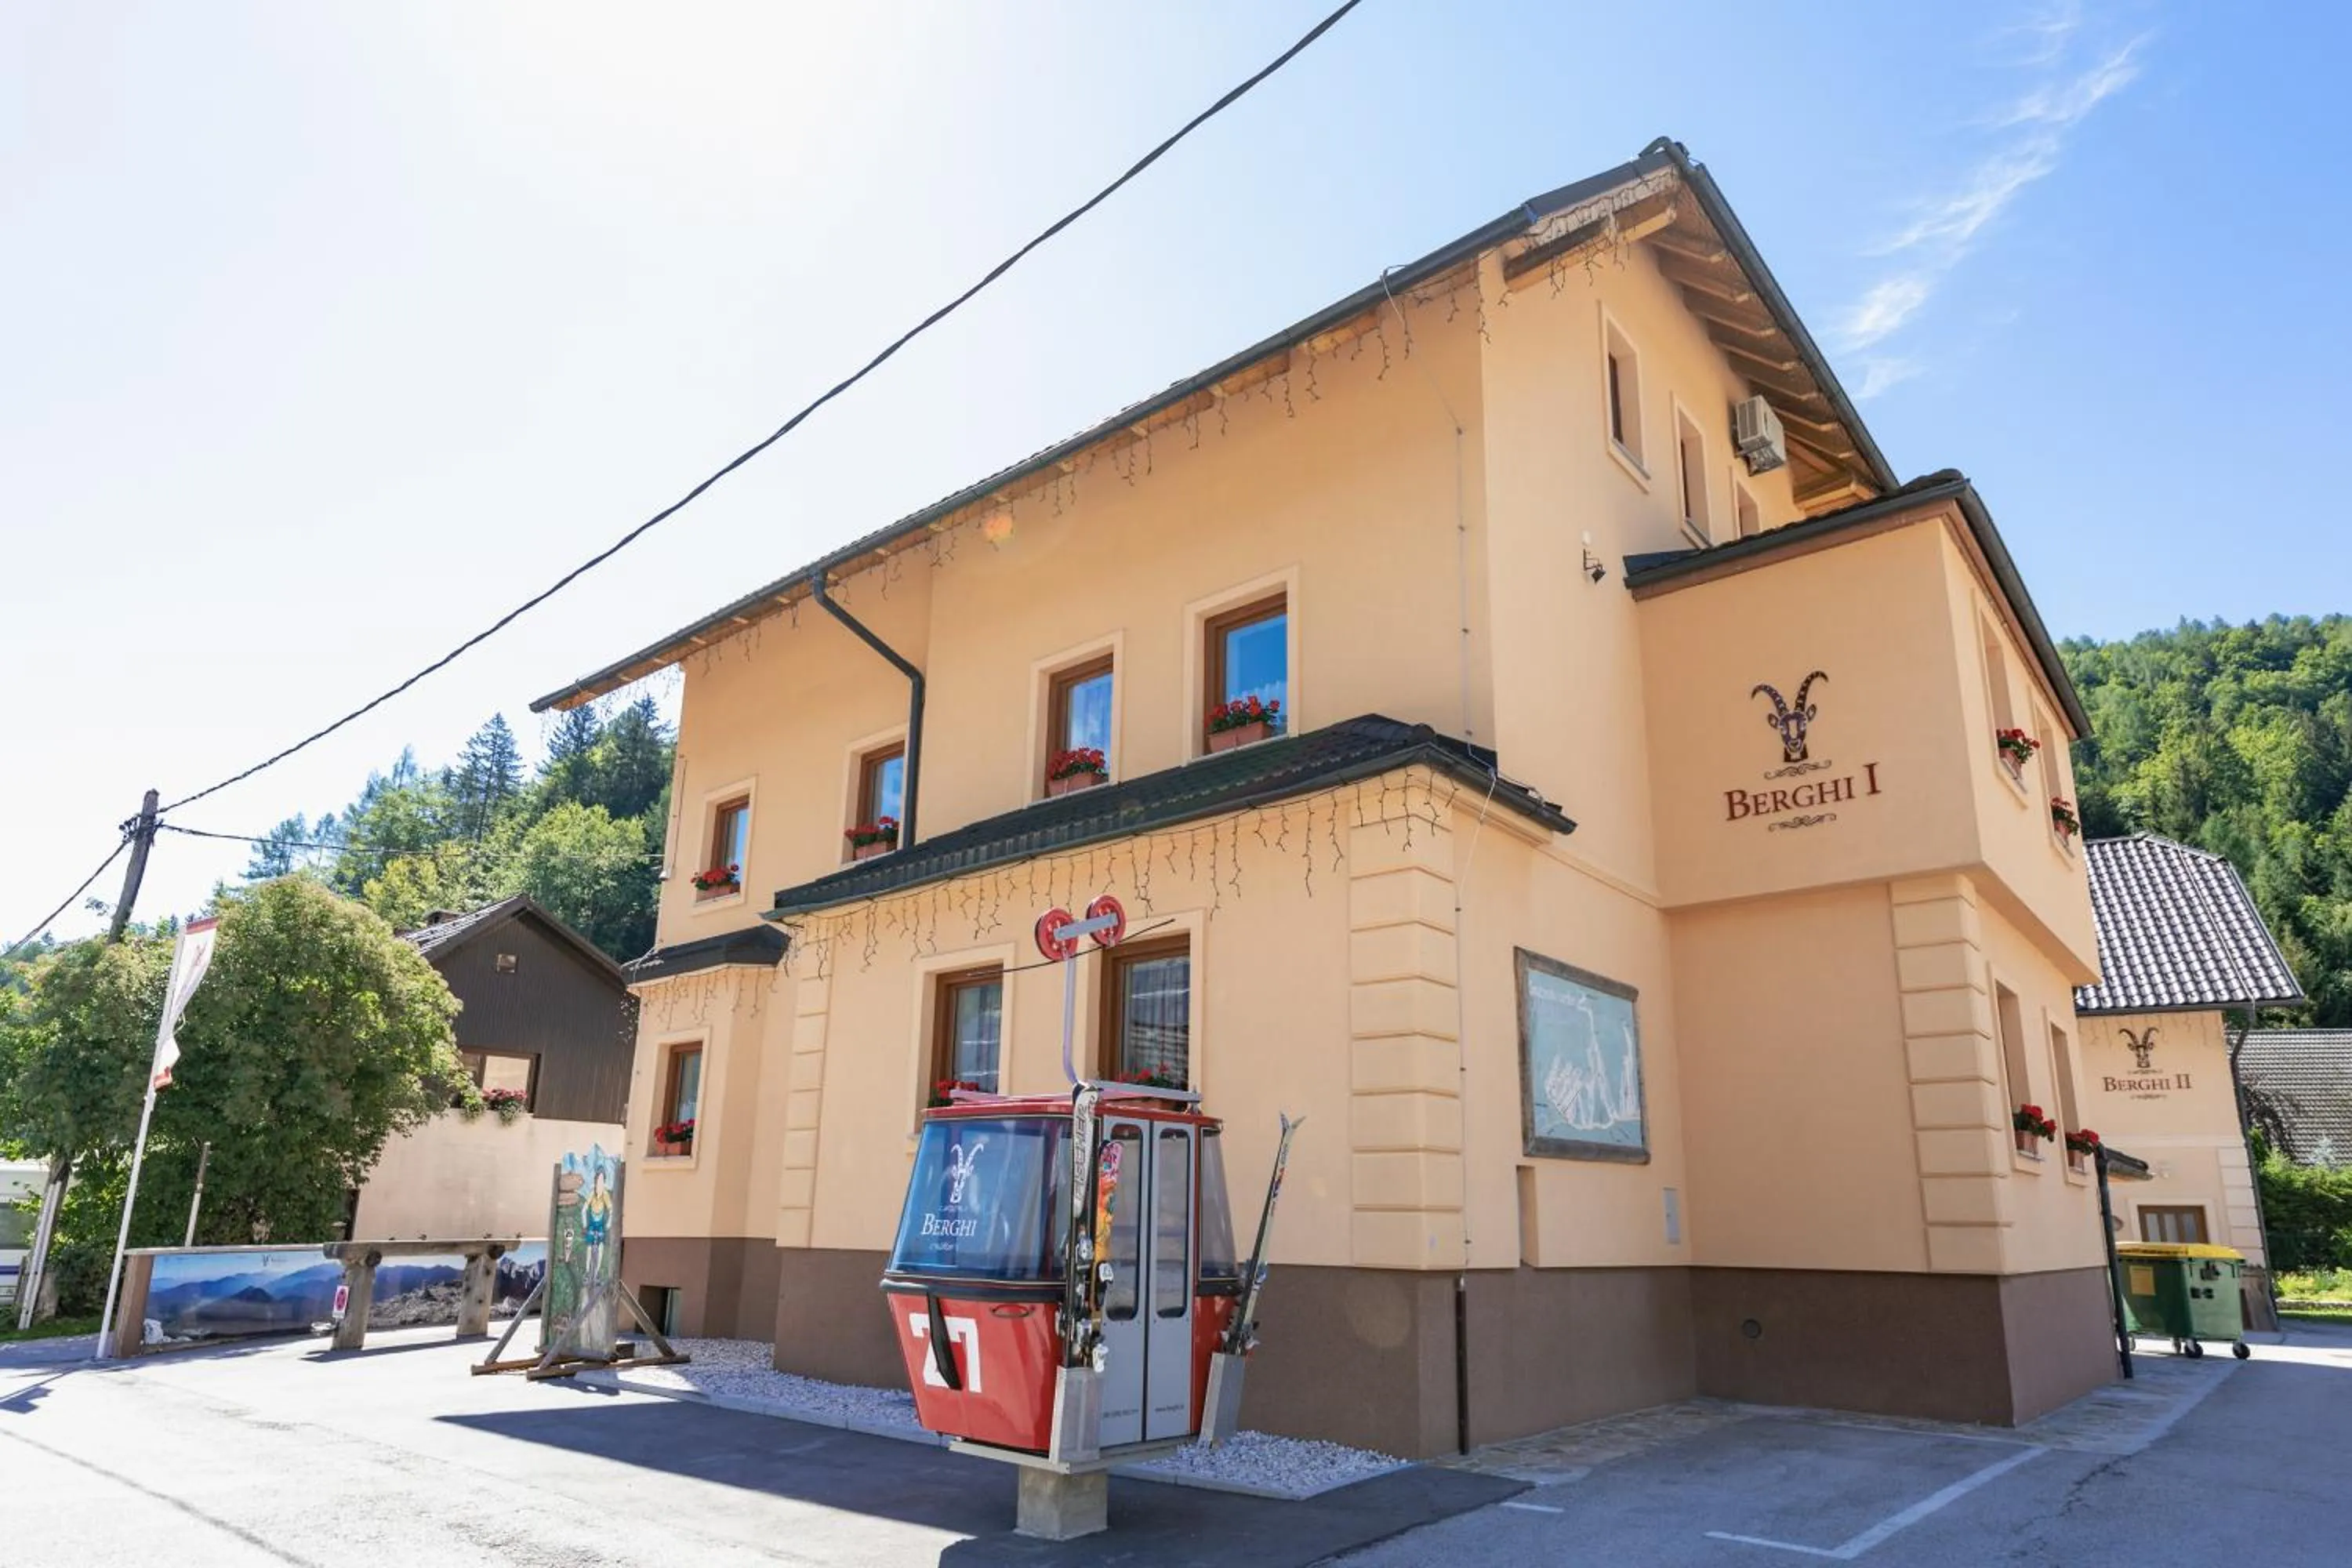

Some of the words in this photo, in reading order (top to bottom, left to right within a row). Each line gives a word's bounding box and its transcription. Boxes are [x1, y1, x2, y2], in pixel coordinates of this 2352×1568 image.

[1724, 776, 1856, 822] BERGHI
[1862, 761, 1882, 797] I
[2103, 1076, 2171, 1092] BERGHI
[2174, 1073, 2192, 1090] II
[920, 1212, 977, 1237] BERGHI
